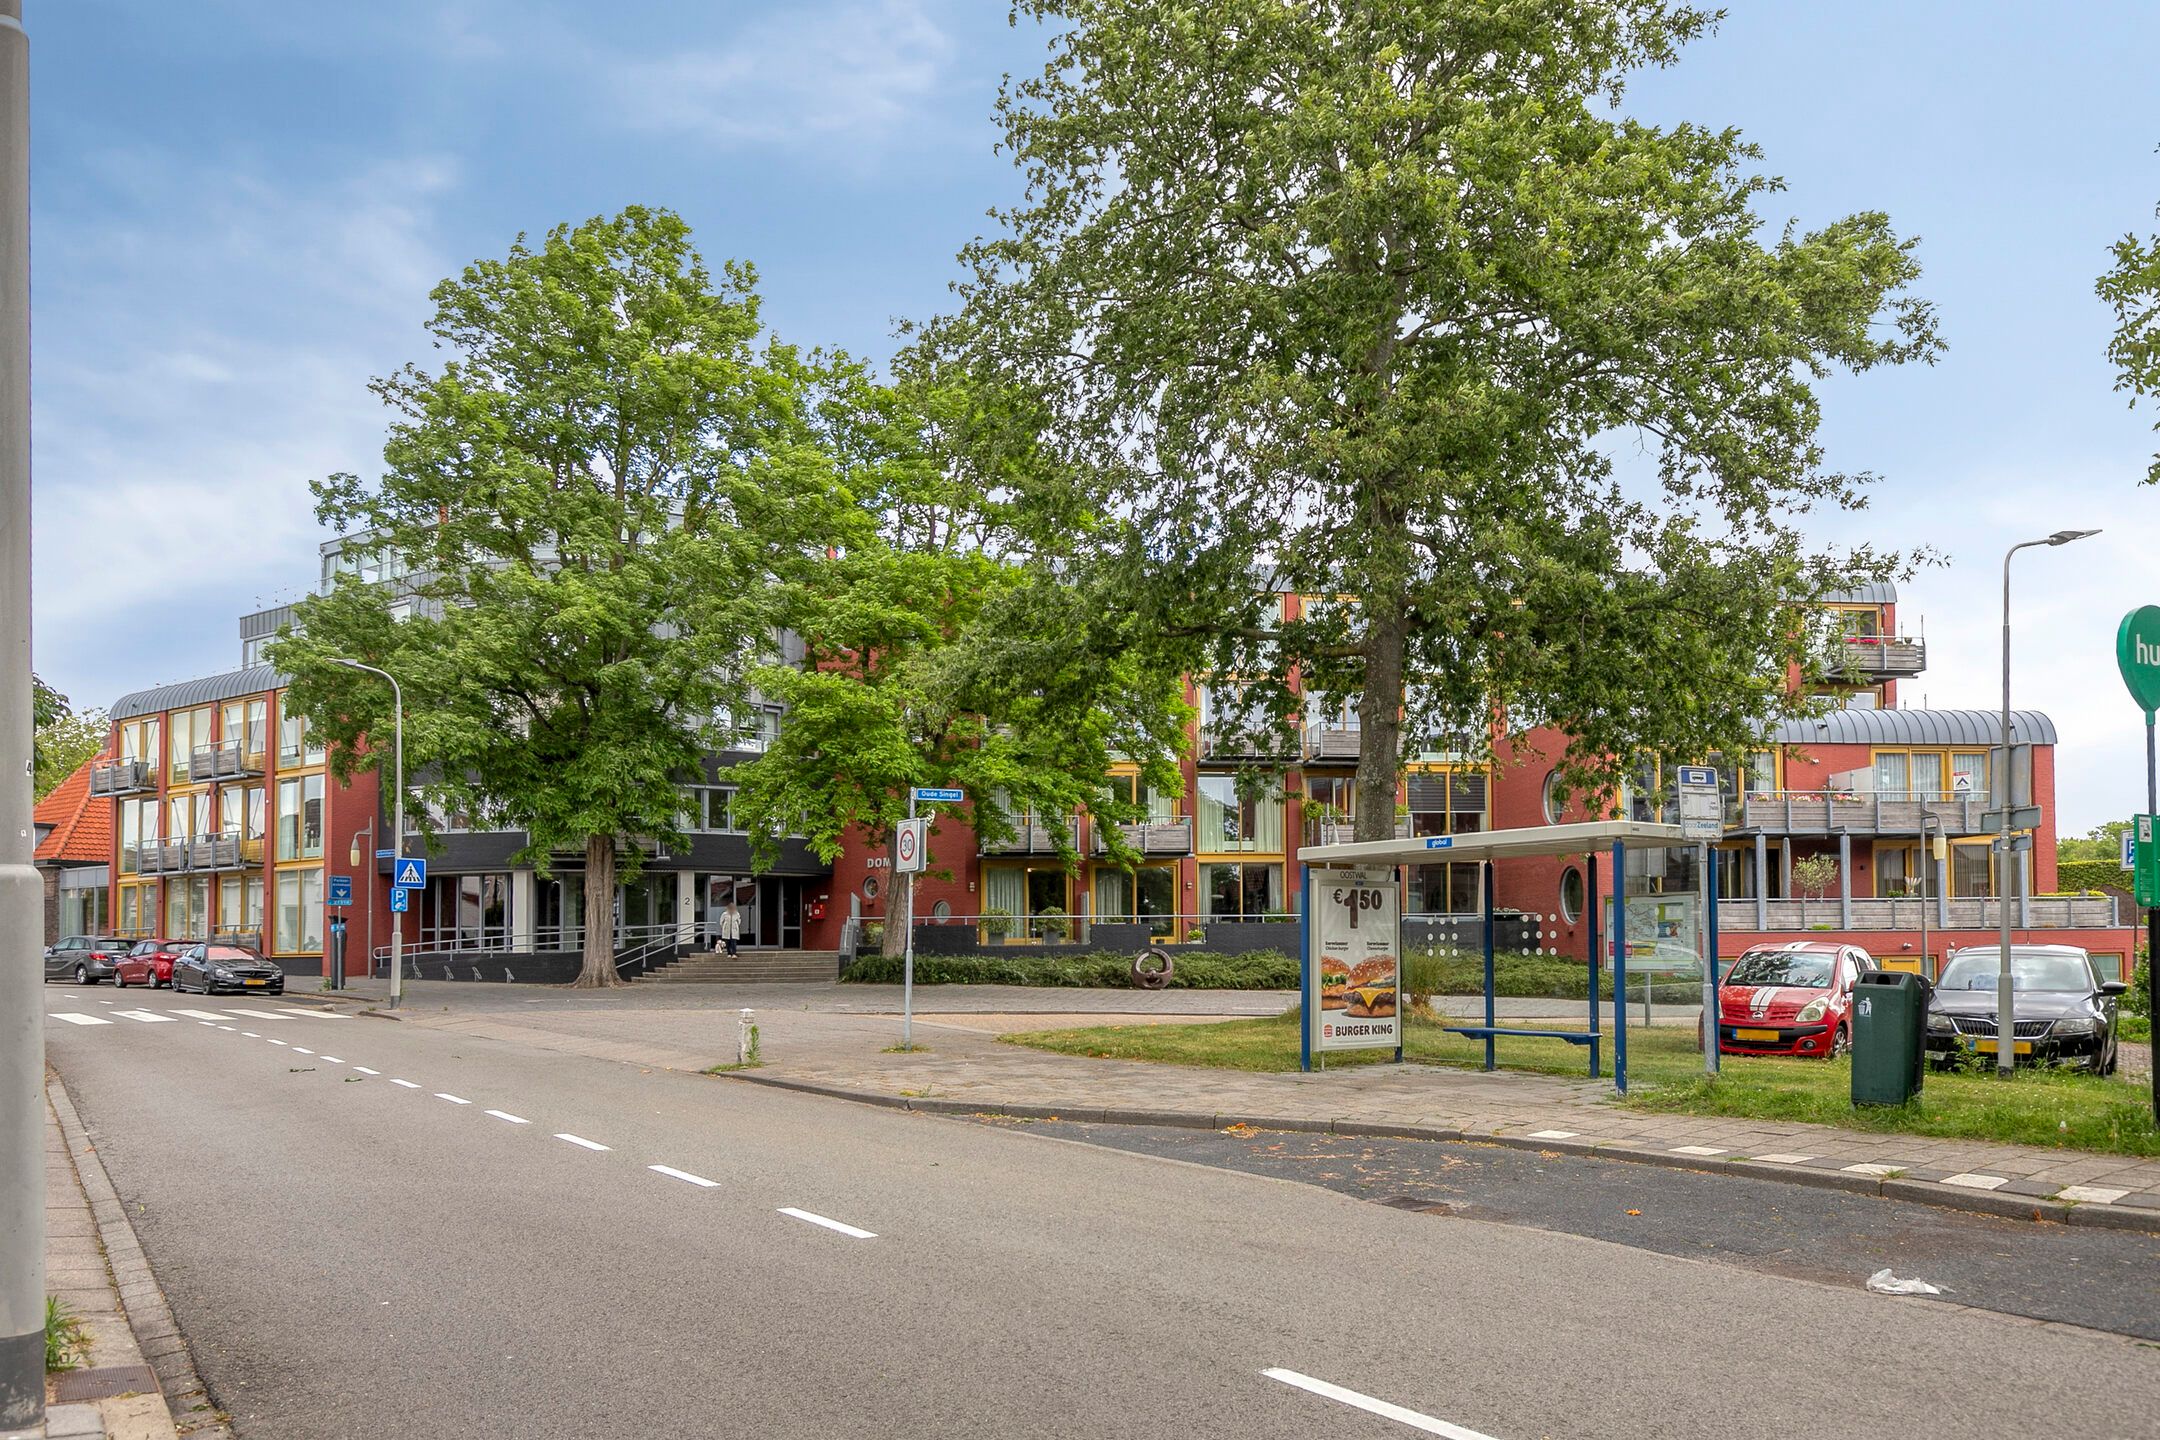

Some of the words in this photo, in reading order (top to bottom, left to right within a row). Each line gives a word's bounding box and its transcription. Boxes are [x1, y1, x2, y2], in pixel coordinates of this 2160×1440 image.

[26, 762, 32, 775] 4
[902, 839, 912, 852] 30
[1431, 838, 1448, 848] global
[1340, 871, 1367, 880] OOSTWAL
[396, 890, 404, 901] P
[684, 897, 691, 905] 2
[1335, 1025, 1370, 1037] BURGER
[1371, 1024, 1393, 1035] KING
